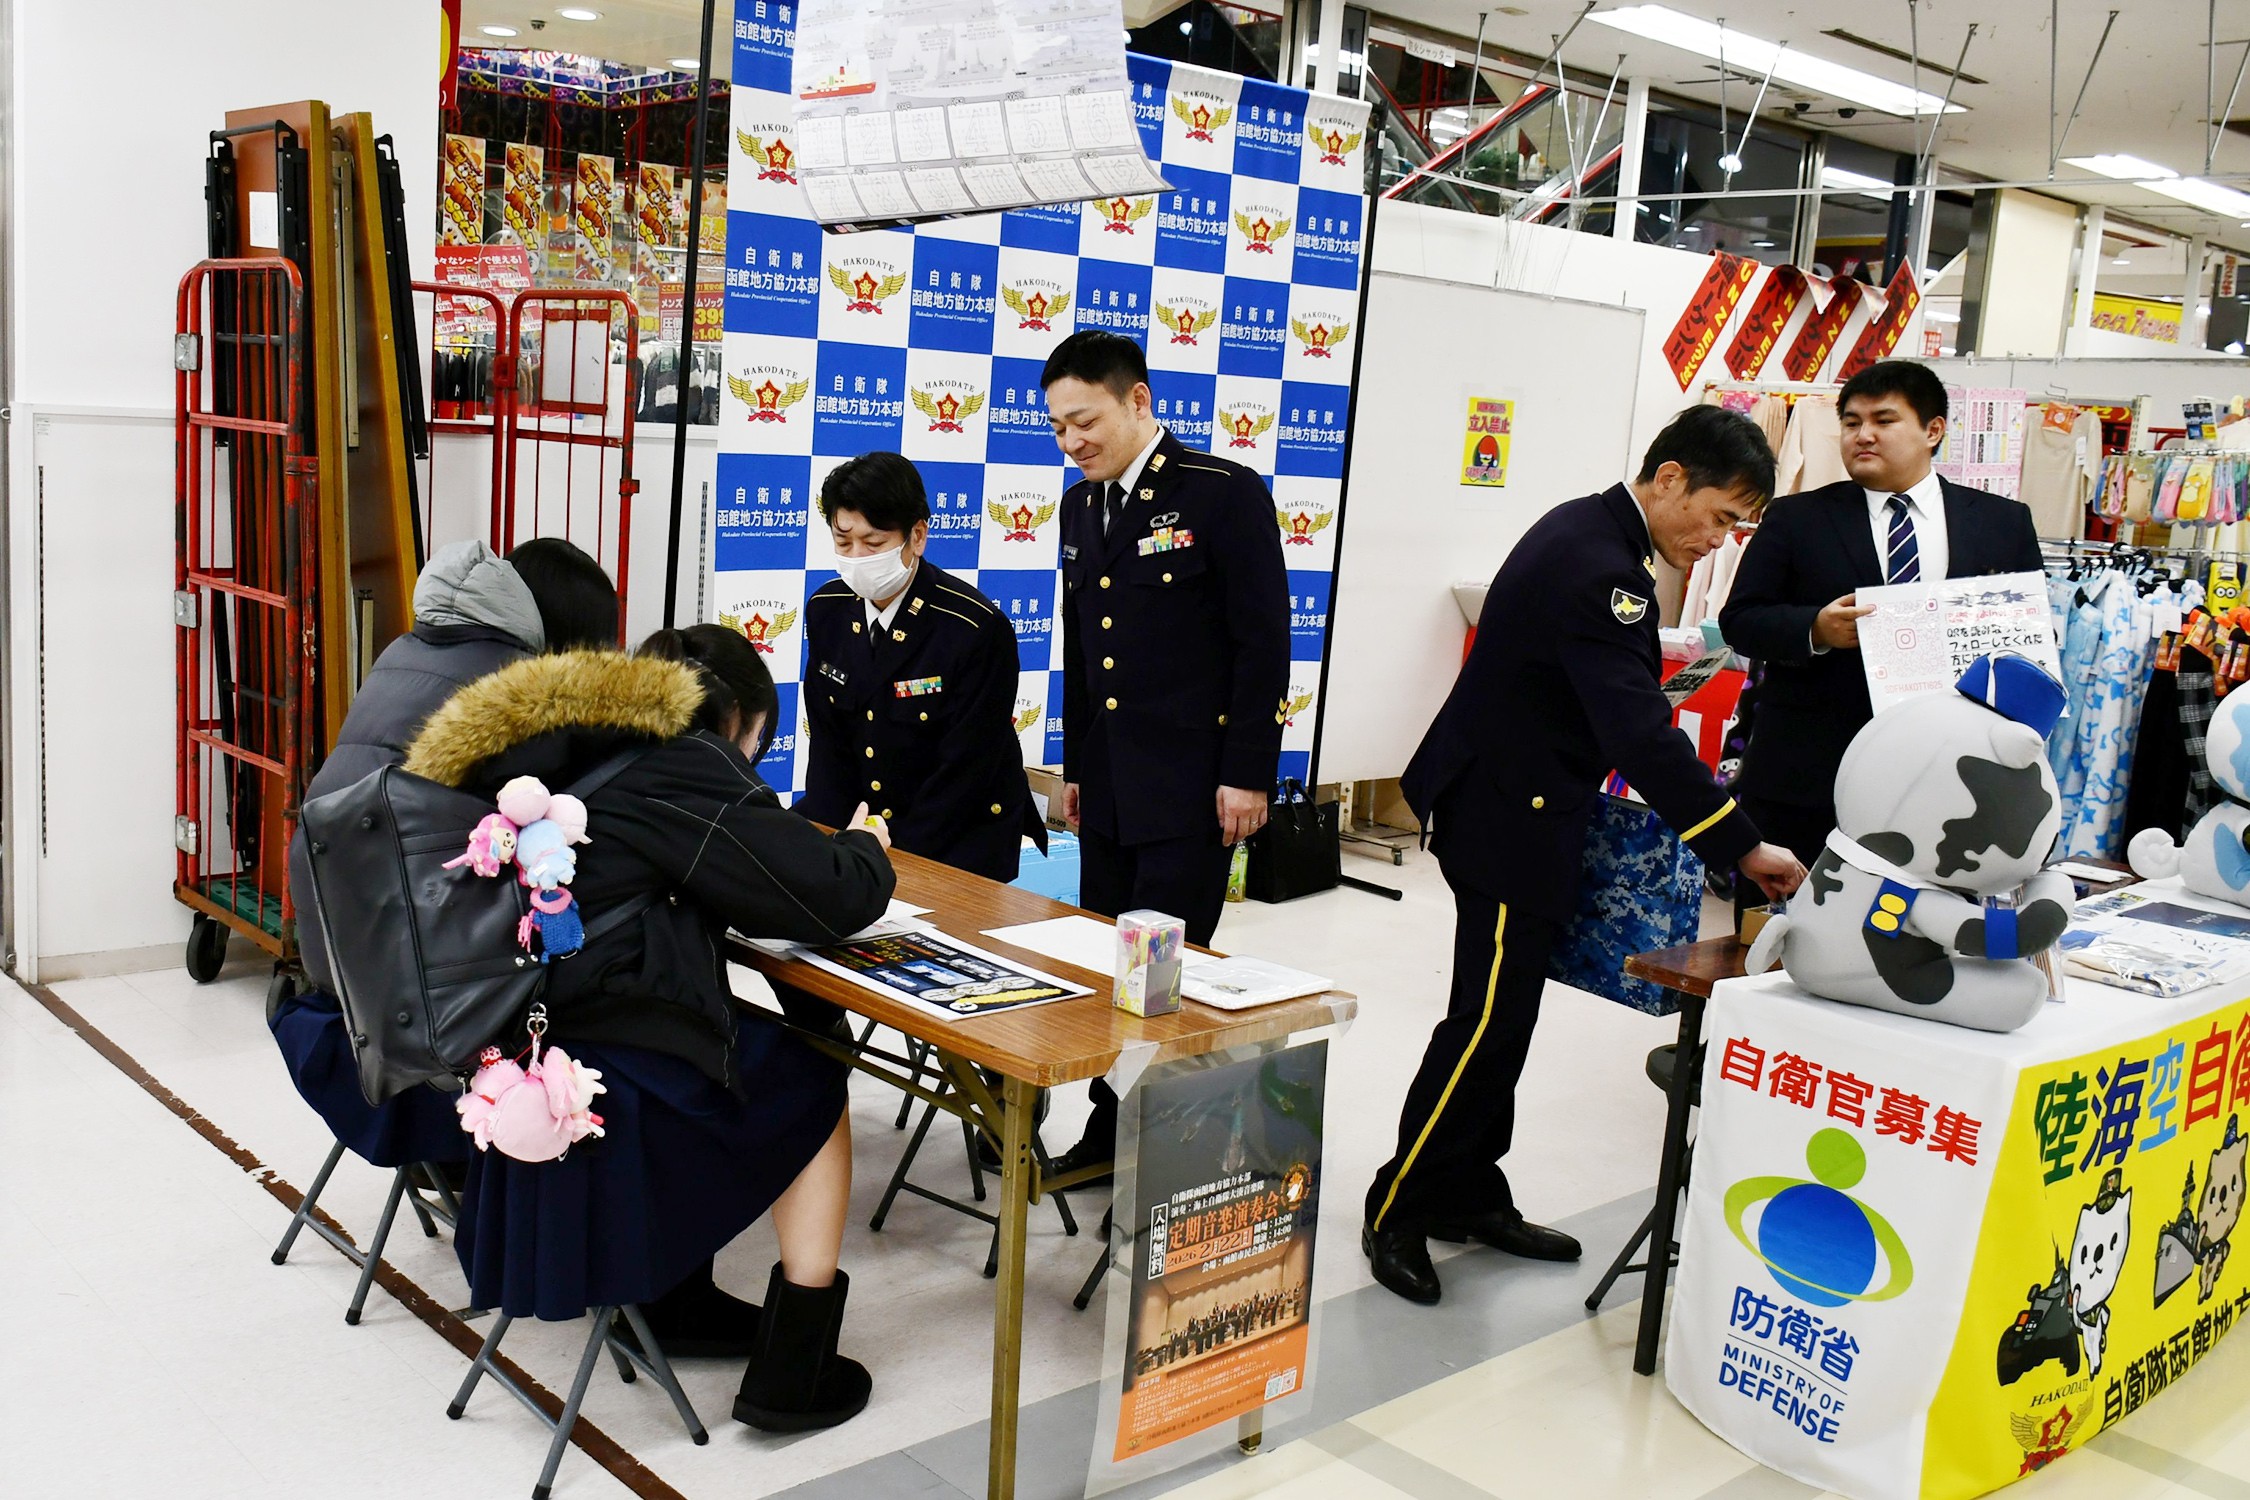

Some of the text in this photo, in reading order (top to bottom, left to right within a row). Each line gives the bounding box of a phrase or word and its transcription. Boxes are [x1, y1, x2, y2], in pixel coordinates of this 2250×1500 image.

[754, 0, 791, 24] 自衛
[735, 19, 796, 48] 函館地方協
[1183, 90, 1223, 102] HAKODATE
[1250, 105, 1291, 125] 自衛隊
[1319, 117, 1354, 128] HAKODATE
[1236, 121, 1302, 146] 函館地方協力本部
[1173, 195, 1216, 215] 自衛隊
[1245, 205, 1282, 217] HAKODATE
[1157, 212, 1227, 235] 函館地方協力本部
[1308, 216, 1348, 234] 自衛隊
[1294, 232, 1358, 254] 函館地方協力本部
[745, 247, 802, 269] 自衛隊
[843, 257, 894, 272] HAKODATE
[726, 268, 818, 293] 函館地方協力本部
[929, 270, 981, 290] 自衛隊
[1015, 278, 1061, 291] HAKODATE
[911, 289, 994, 312] 函館地方協力本部
[1092, 289, 1137, 307] 自衛隊
[1168, 296, 1206, 307] HAKODATE
[1076, 307, 1149, 329] 函館地方協力本部
[1234, 305, 1274, 322] 自衛隊
[1302, 312, 1339, 321] HAKODATE
[1221, 323, 1285, 342] 函館地方協力本部
[743, 365, 797, 379] HAKODATE
[834, 375, 887, 393] 自衛隊
[925, 380, 974, 392] HAKODATE
[1005, 387, 1036, 404] 自衛
[816, 395, 902, 416] 函館地方協力本部
[1158, 399, 1199, 415] 自衛隊
[1228, 402, 1265, 412] HAKODATE
[989, 407, 1046, 425] 函館地方協力
[1292, 408, 1333, 424] 自衛隊
[1468, 414, 1510, 434] 立入禁止
[1278, 425, 1344, 443] 函館地方協力本部
[735, 487, 791, 504] 自衛隊
[936, 492, 968, 509] 衛隊
[1000, 491, 1046, 502] HAKODATE
[1286, 500, 1323, 510] HAKODATE
[717, 509, 806, 526] 函館地方協力本部
[928, 513, 980, 530] 方協力本部
[732, 599, 785, 611] HAKODATE
[1290, 613, 1326, 628] 協力本部
[1949, 633, 2042, 652] フォローしてくれた
[1720, 1037, 1982, 1166] 自衛官募集
[1168, 1190, 1279, 1250] 定期音楽演奏会
[1150, 1209, 1166, 1275] 入場無料
[1167, 1250, 1196, 1268] 2026
[1729, 1286, 1860, 1382] 防衛省
[1724, 1342, 1846, 1415] MINISTRY OF
[2030, 1379, 2089, 1408] HAKODATE
[1718, 1362, 1840, 1444] DEFENSE
